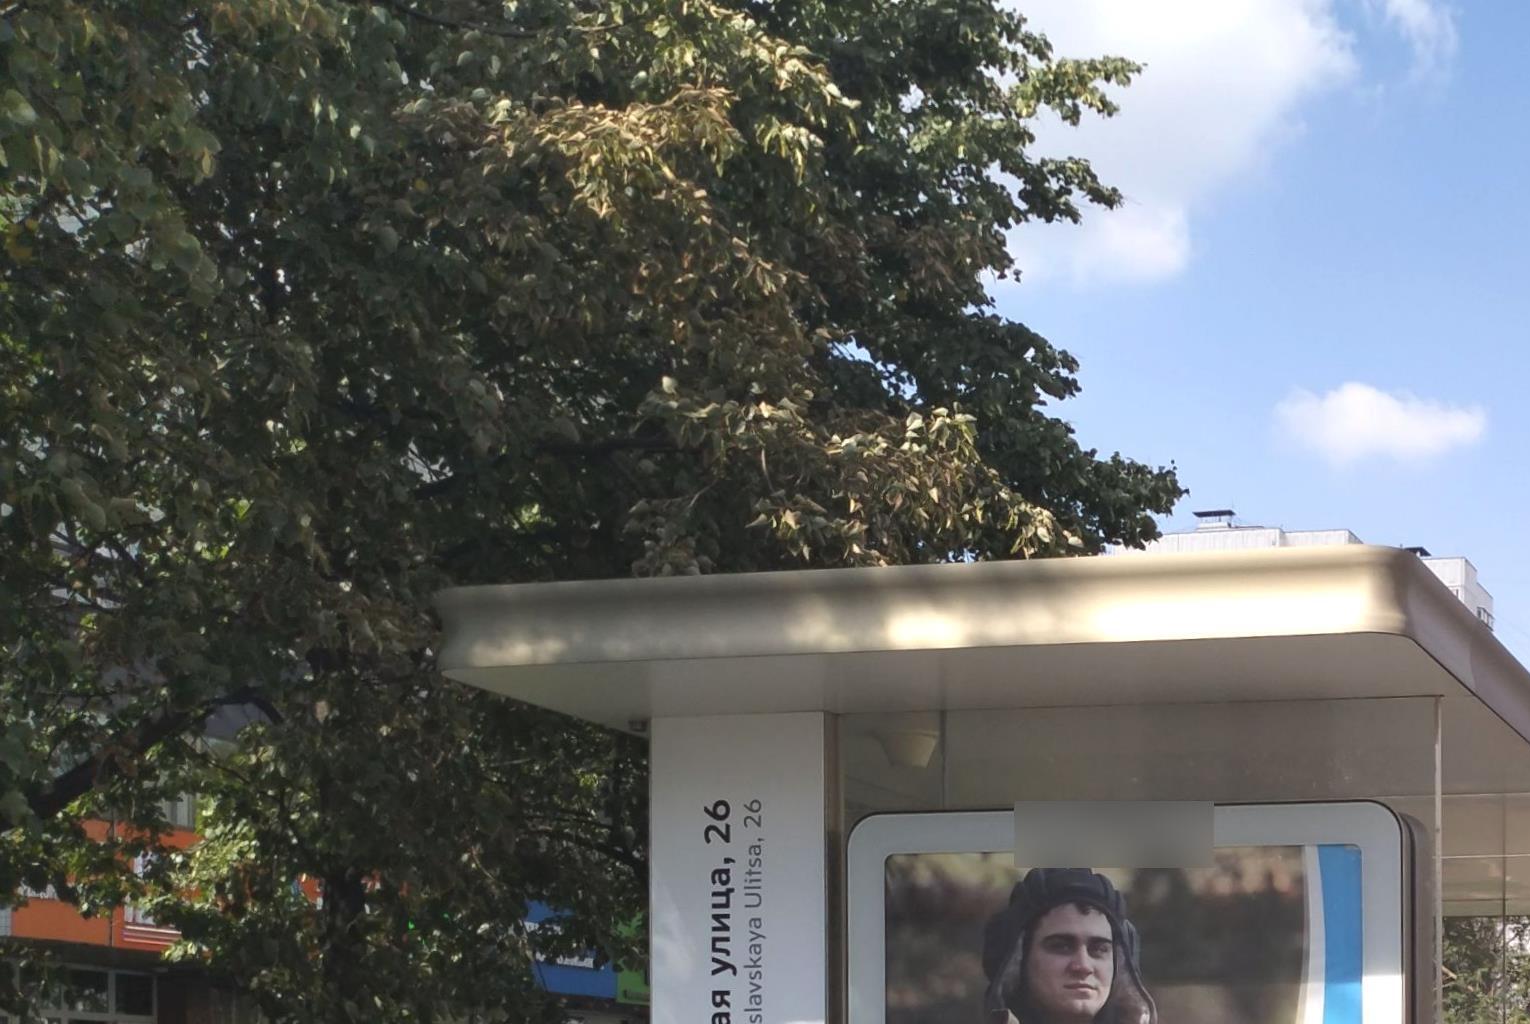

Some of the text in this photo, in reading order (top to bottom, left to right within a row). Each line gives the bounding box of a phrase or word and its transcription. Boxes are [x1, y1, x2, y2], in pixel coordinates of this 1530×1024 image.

[703, 799, 731, 844] 26
[743, 799, 762, 828] 26
[744, 837, 765, 908] Ulitsa,
[711, 857, 738, 977] улица,
